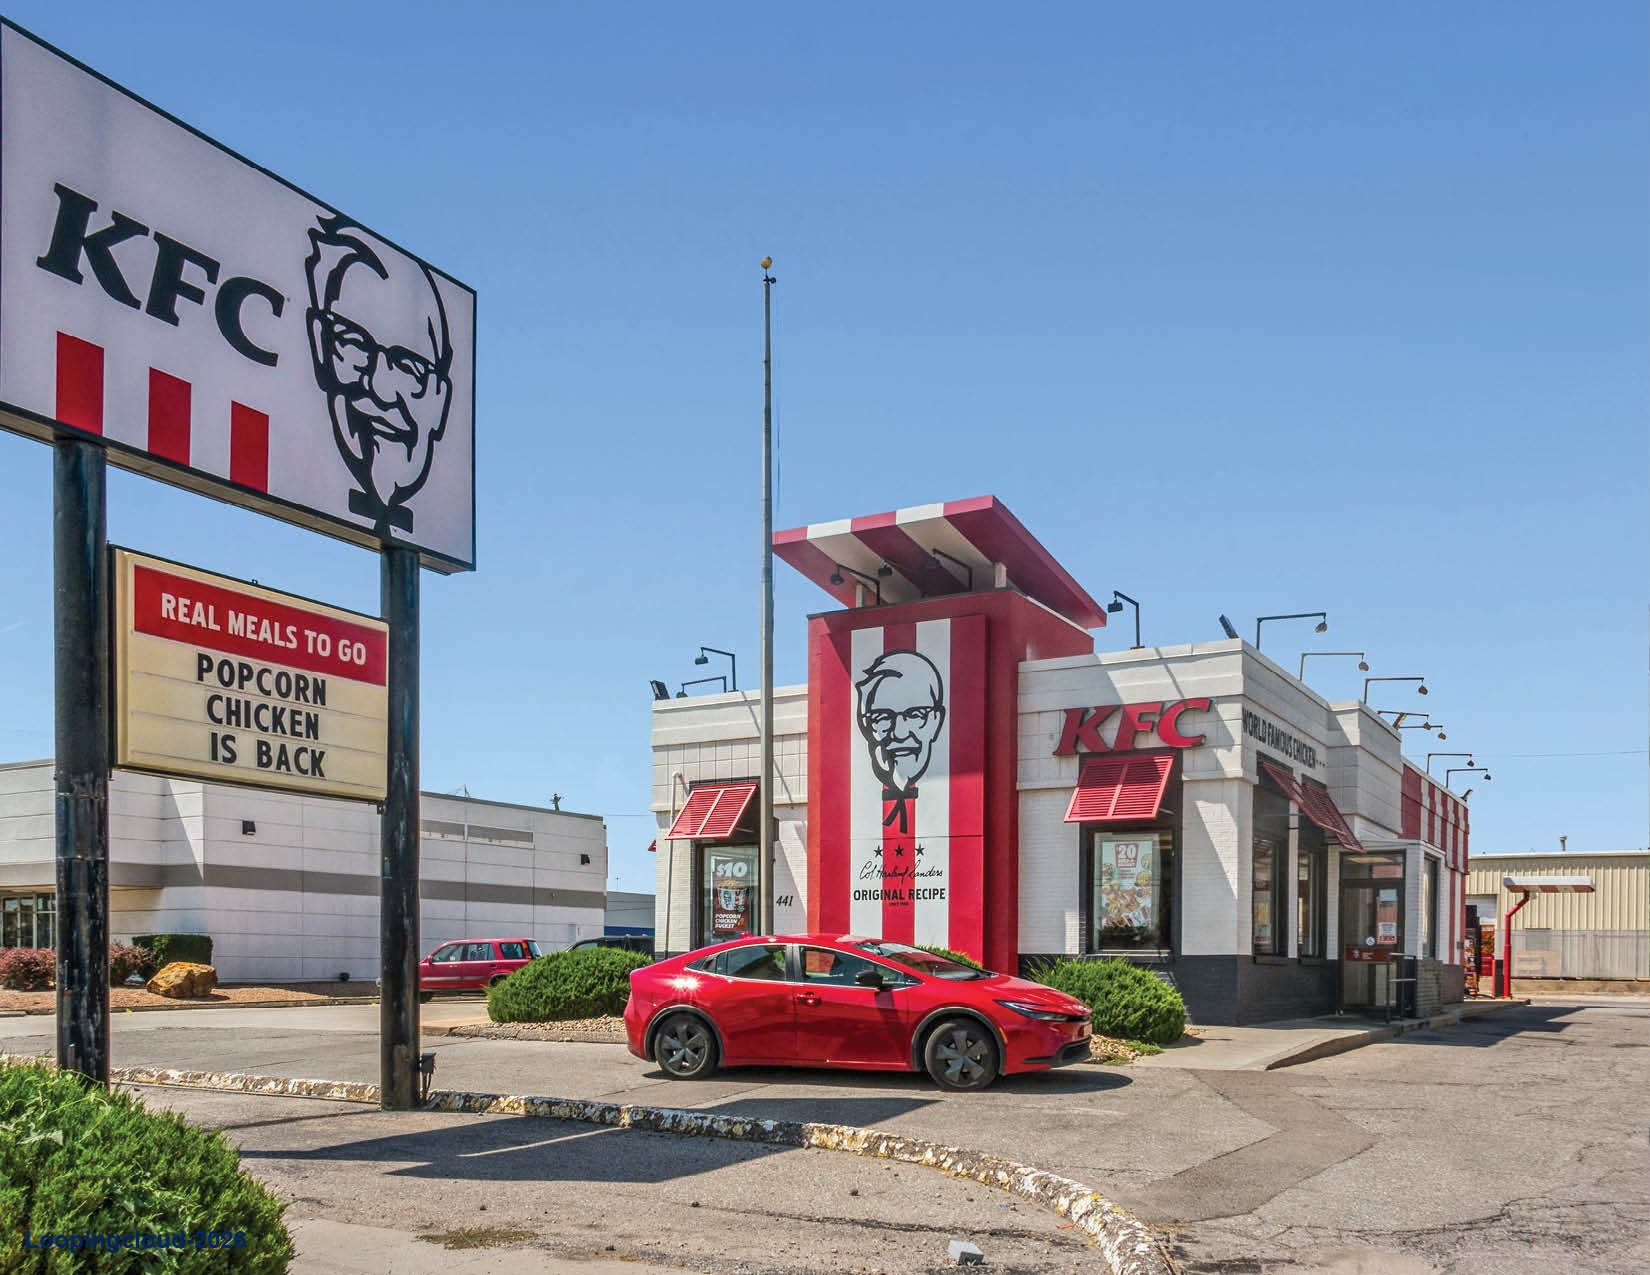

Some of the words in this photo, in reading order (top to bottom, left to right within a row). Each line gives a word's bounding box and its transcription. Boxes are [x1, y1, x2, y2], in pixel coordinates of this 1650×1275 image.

[36, 182, 286, 368] KFC
[161, 592, 221, 632] REAL
[228, 610, 297, 649] MEALS
[304, 629, 331, 657] TO
[338, 639, 367, 665] GO
[197, 652, 327, 706] POPCORN
[206, 694, 319, 740] CHICKEN
[1053, 697, 1212, 756] KFC
[1242, 706, 1267, 744] WORLD
[1267, 722, 1293, 758] FAMOUS
[1293, 737, 1317, 770] CHICKEN
[210, 731, 237, 764] IS
[256, 739, 326, 777] BACK
[716, 861, 748, 878] $10
[853, 888, 906, 901] ORIGINAL
[908, 887, 946, 901] RECIPE
[776, 894, 794, 907] 441
